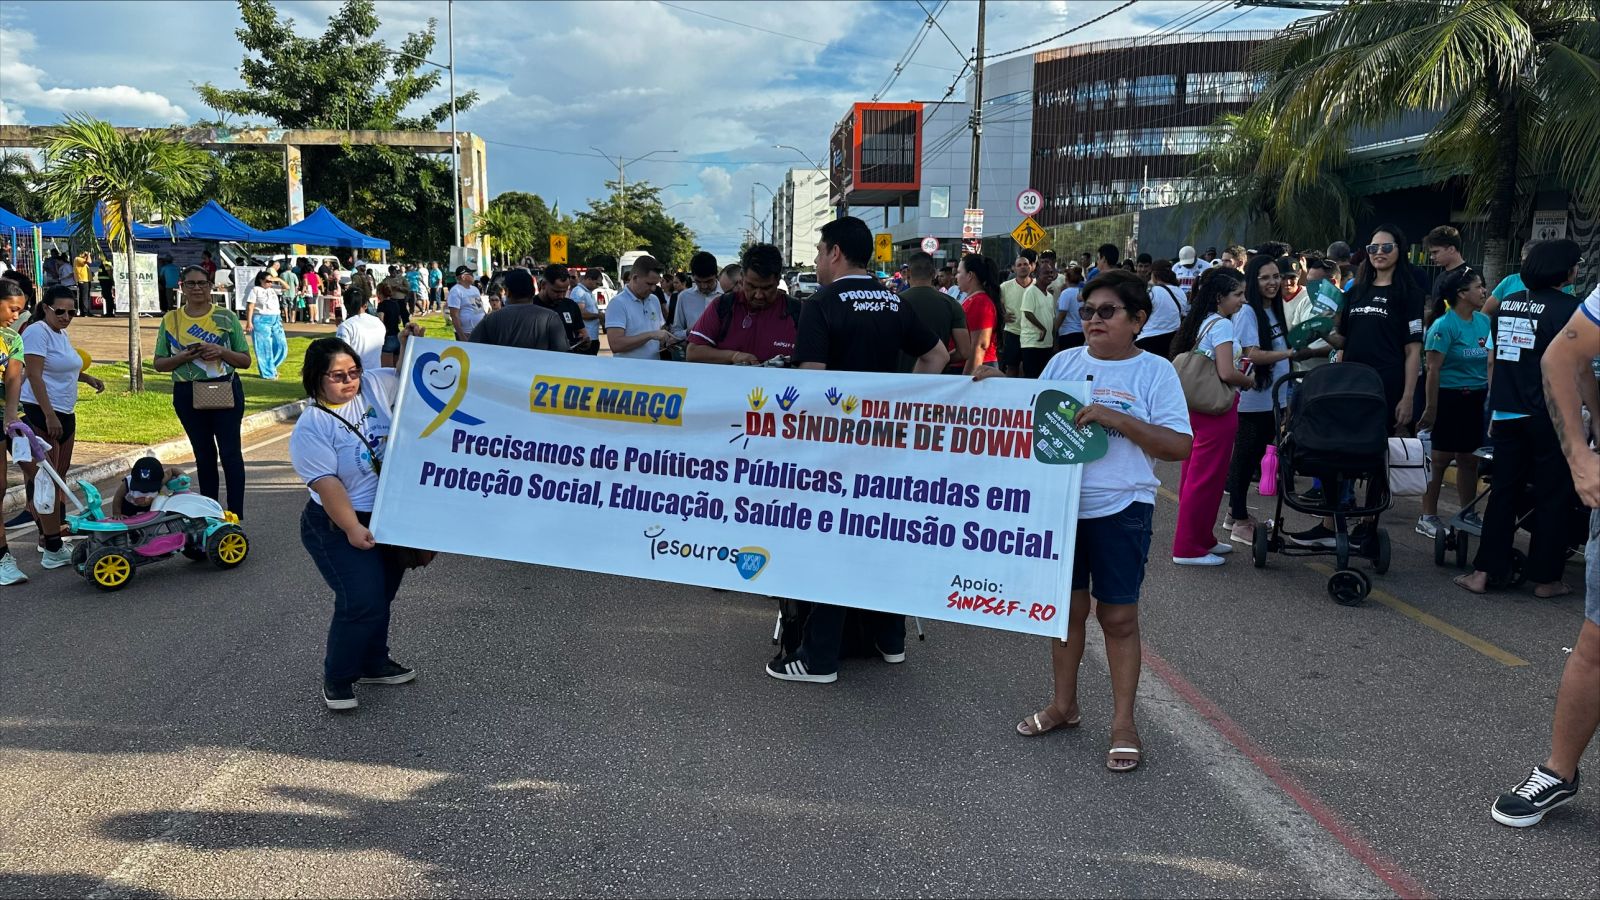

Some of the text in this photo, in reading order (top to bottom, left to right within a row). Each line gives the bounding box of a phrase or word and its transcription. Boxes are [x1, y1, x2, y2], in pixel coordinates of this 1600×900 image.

[1024, 195, 1037, 205] 30
[119, 272, 153, 281] SEAM
[839, 290, 901, 303] PRODUÇÃO
[534, 381, 682, 423] 21 DE MARÇO
[861, 399, 1033, 430] DIA INTERNACIONAL
[745, 411, 776, 437] DA
[782, 409, 907, 448] SÍNDROME
[913, 424, 944, 452] DE
[950, 427, 1033, 459] DOWN
[451, 428, 1031, 514] Precisamos de Políticas Públicas, pautadas em
[419, 461, 1059, 561] Proteção Social, Educação, Saúde e Inclusão Social.
[644, 528, 740, 564] Tesouros
[950, 574, 1003, 594] Apoio:
[946, 591, 1056, 621] SINDSEF-RO
